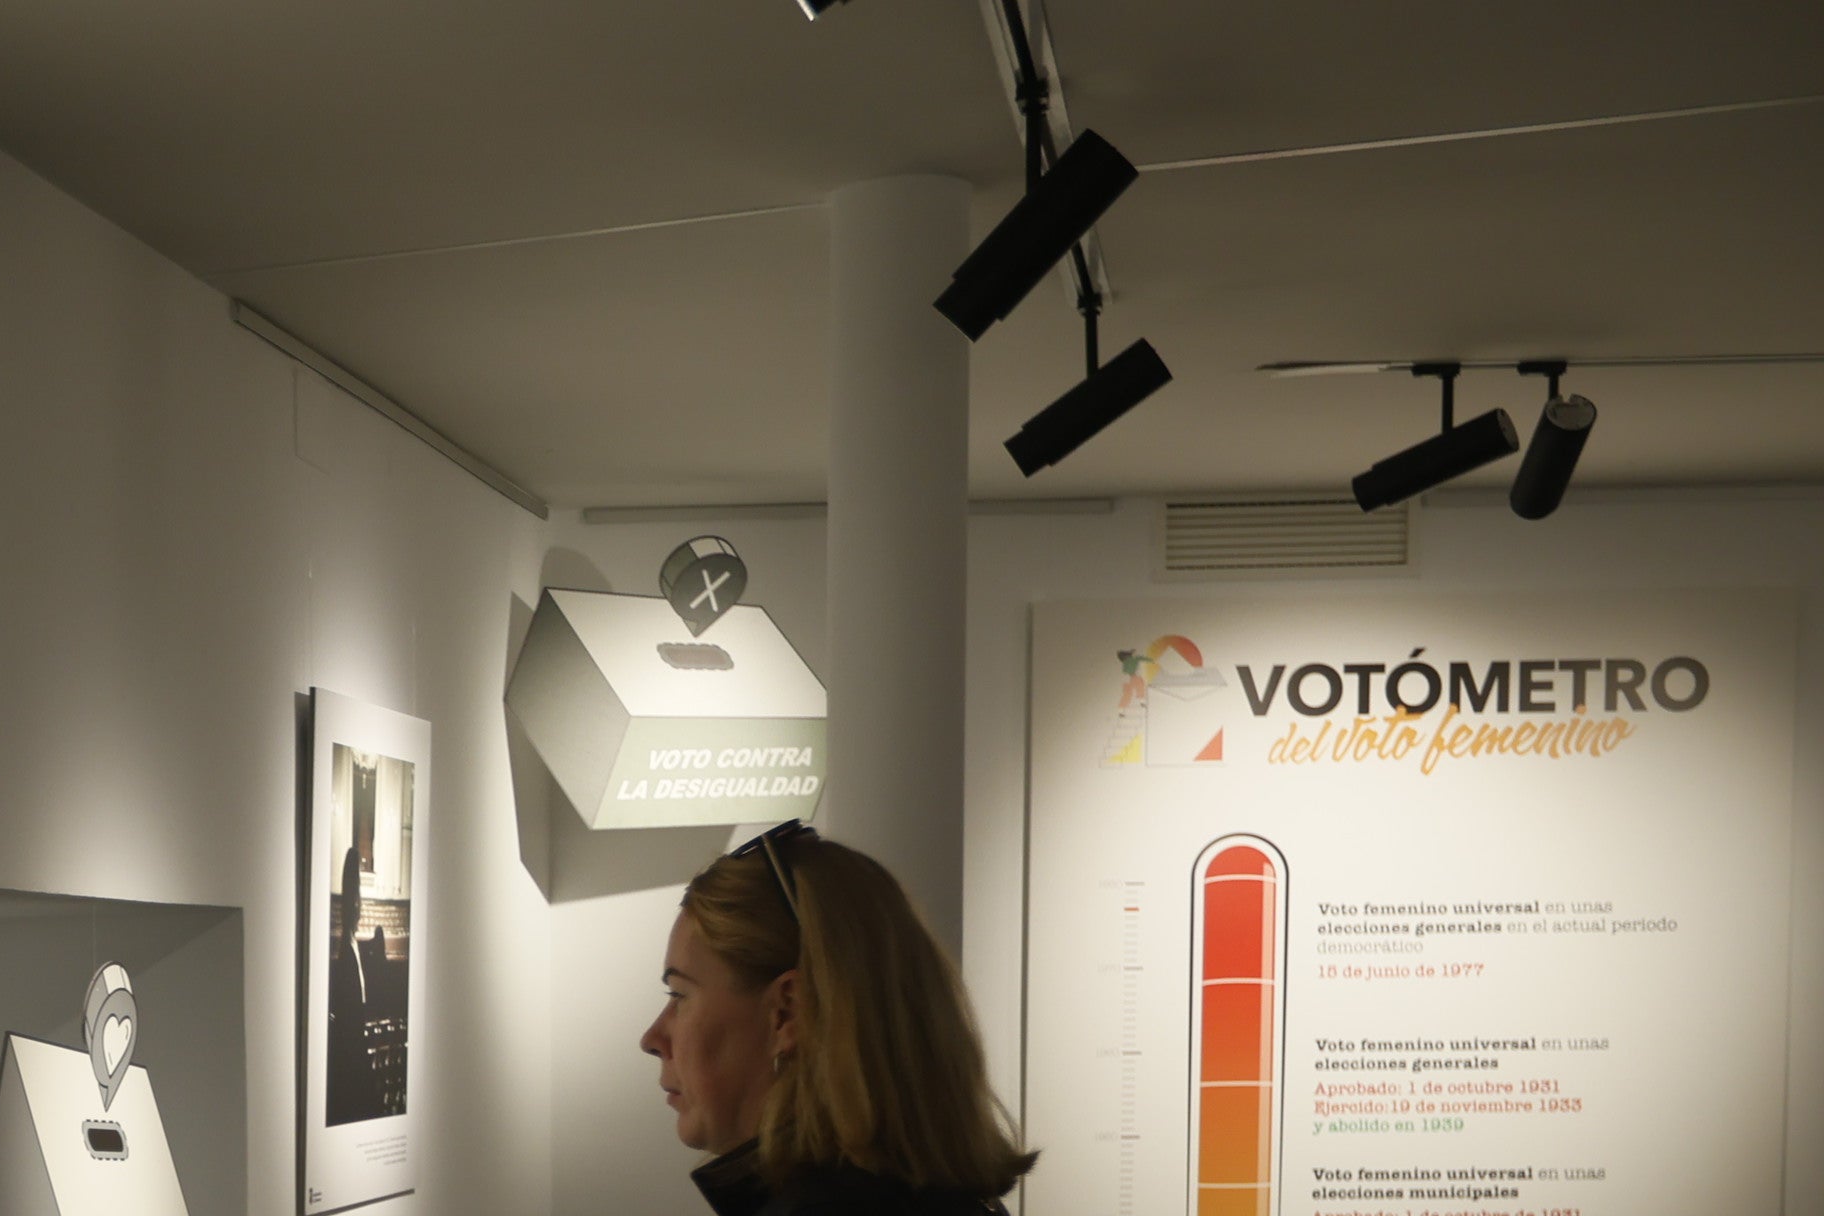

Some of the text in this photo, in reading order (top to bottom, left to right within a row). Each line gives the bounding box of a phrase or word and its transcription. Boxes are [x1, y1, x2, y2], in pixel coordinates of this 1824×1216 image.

[1235, 647, 1710, 717] VOTÓMETRO
[1269, 722, 1330, 765] del
[1420, 702, 1636, 776] femenino
[649, 746, 813, 770] VOTO CONTRA
[617, 775, 819, 800] LA DESIGUALDAD
[1318, 902, 1613, 916] Voto femenino universal en unas
[1318, 921, 1410, 935] elecciones
[1415, 921, 1502, 937] generales
[1507, 921, 1528, 935] en
[1533, 919, 1547, 933] el
[1552, 919, 1606, 933] actual
[1343, 964, 1362, 979] de
[1367, 963, 1410, 981] junio
[1415, 964, 1434, 979] de
[1442, 963, 1484, 978] 1977
[1316, 1037, 1609, 1051] Voto femenino universal en unas
[1315, 1058, 1499, 1073] elecciones generales
[1314, 1081, 1402, 1097] Aprobado:
[1422, 1081, 1442, 1095] de
[1448, 1081, 1513, 1095] octubre
[1416, 1099, 1435, 1113] de
[1441, 1099, 1532, 1113] noviembre
[1329, 1119, 1390, 1132] abolido
[1394, 1119, 1415, 1132] en
[1313, 1167, 1606, 1181] Voto femenino universal en unas
[1312, 1186, 1519, 1202] elecciones municipales
